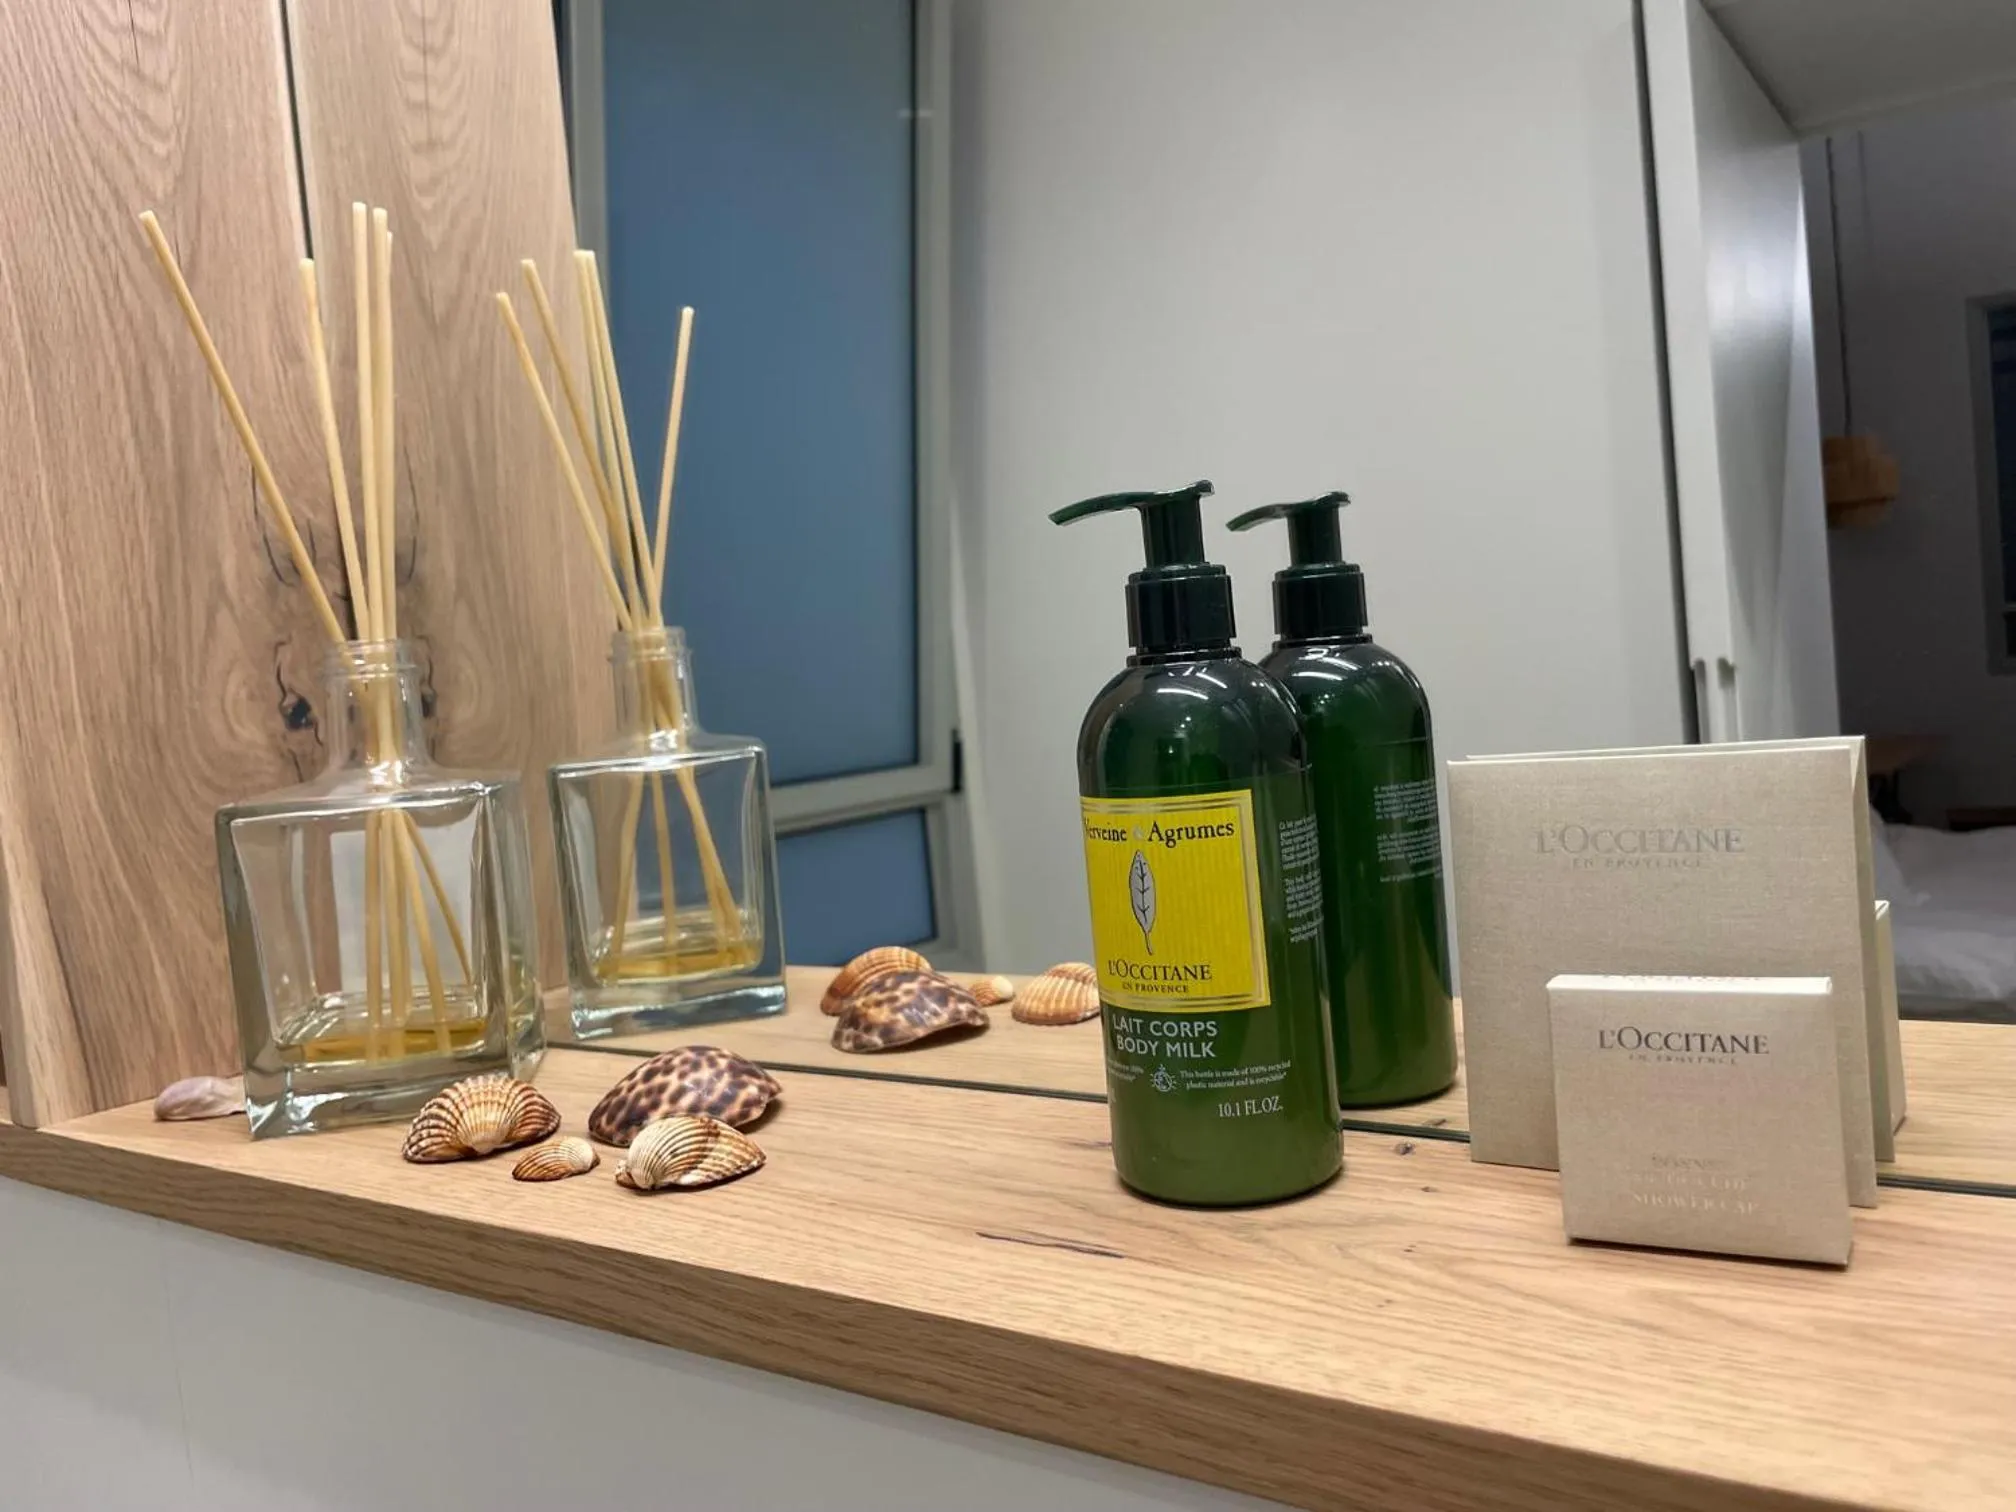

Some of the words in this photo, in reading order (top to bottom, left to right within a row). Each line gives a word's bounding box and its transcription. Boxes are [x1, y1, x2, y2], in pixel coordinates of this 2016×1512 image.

[1147, 821, 1235, 849] Agrumes
[1108, 958, 1213, 981] L'OCCITANE
[1135, 983, 1189, 993] PROVENCE
[1112, 1013, 1144, 1035] LAIT
[1149, 1020, 1218, 1037] CORPS
[1116, 1035, 1158, 1057] BODY
[1166, 1041, 1217, 1058] MILK
[1598, 1025, 1770, 1055] L'OCCITANE
[1218, 1102, 1240, 1117] 10.1
